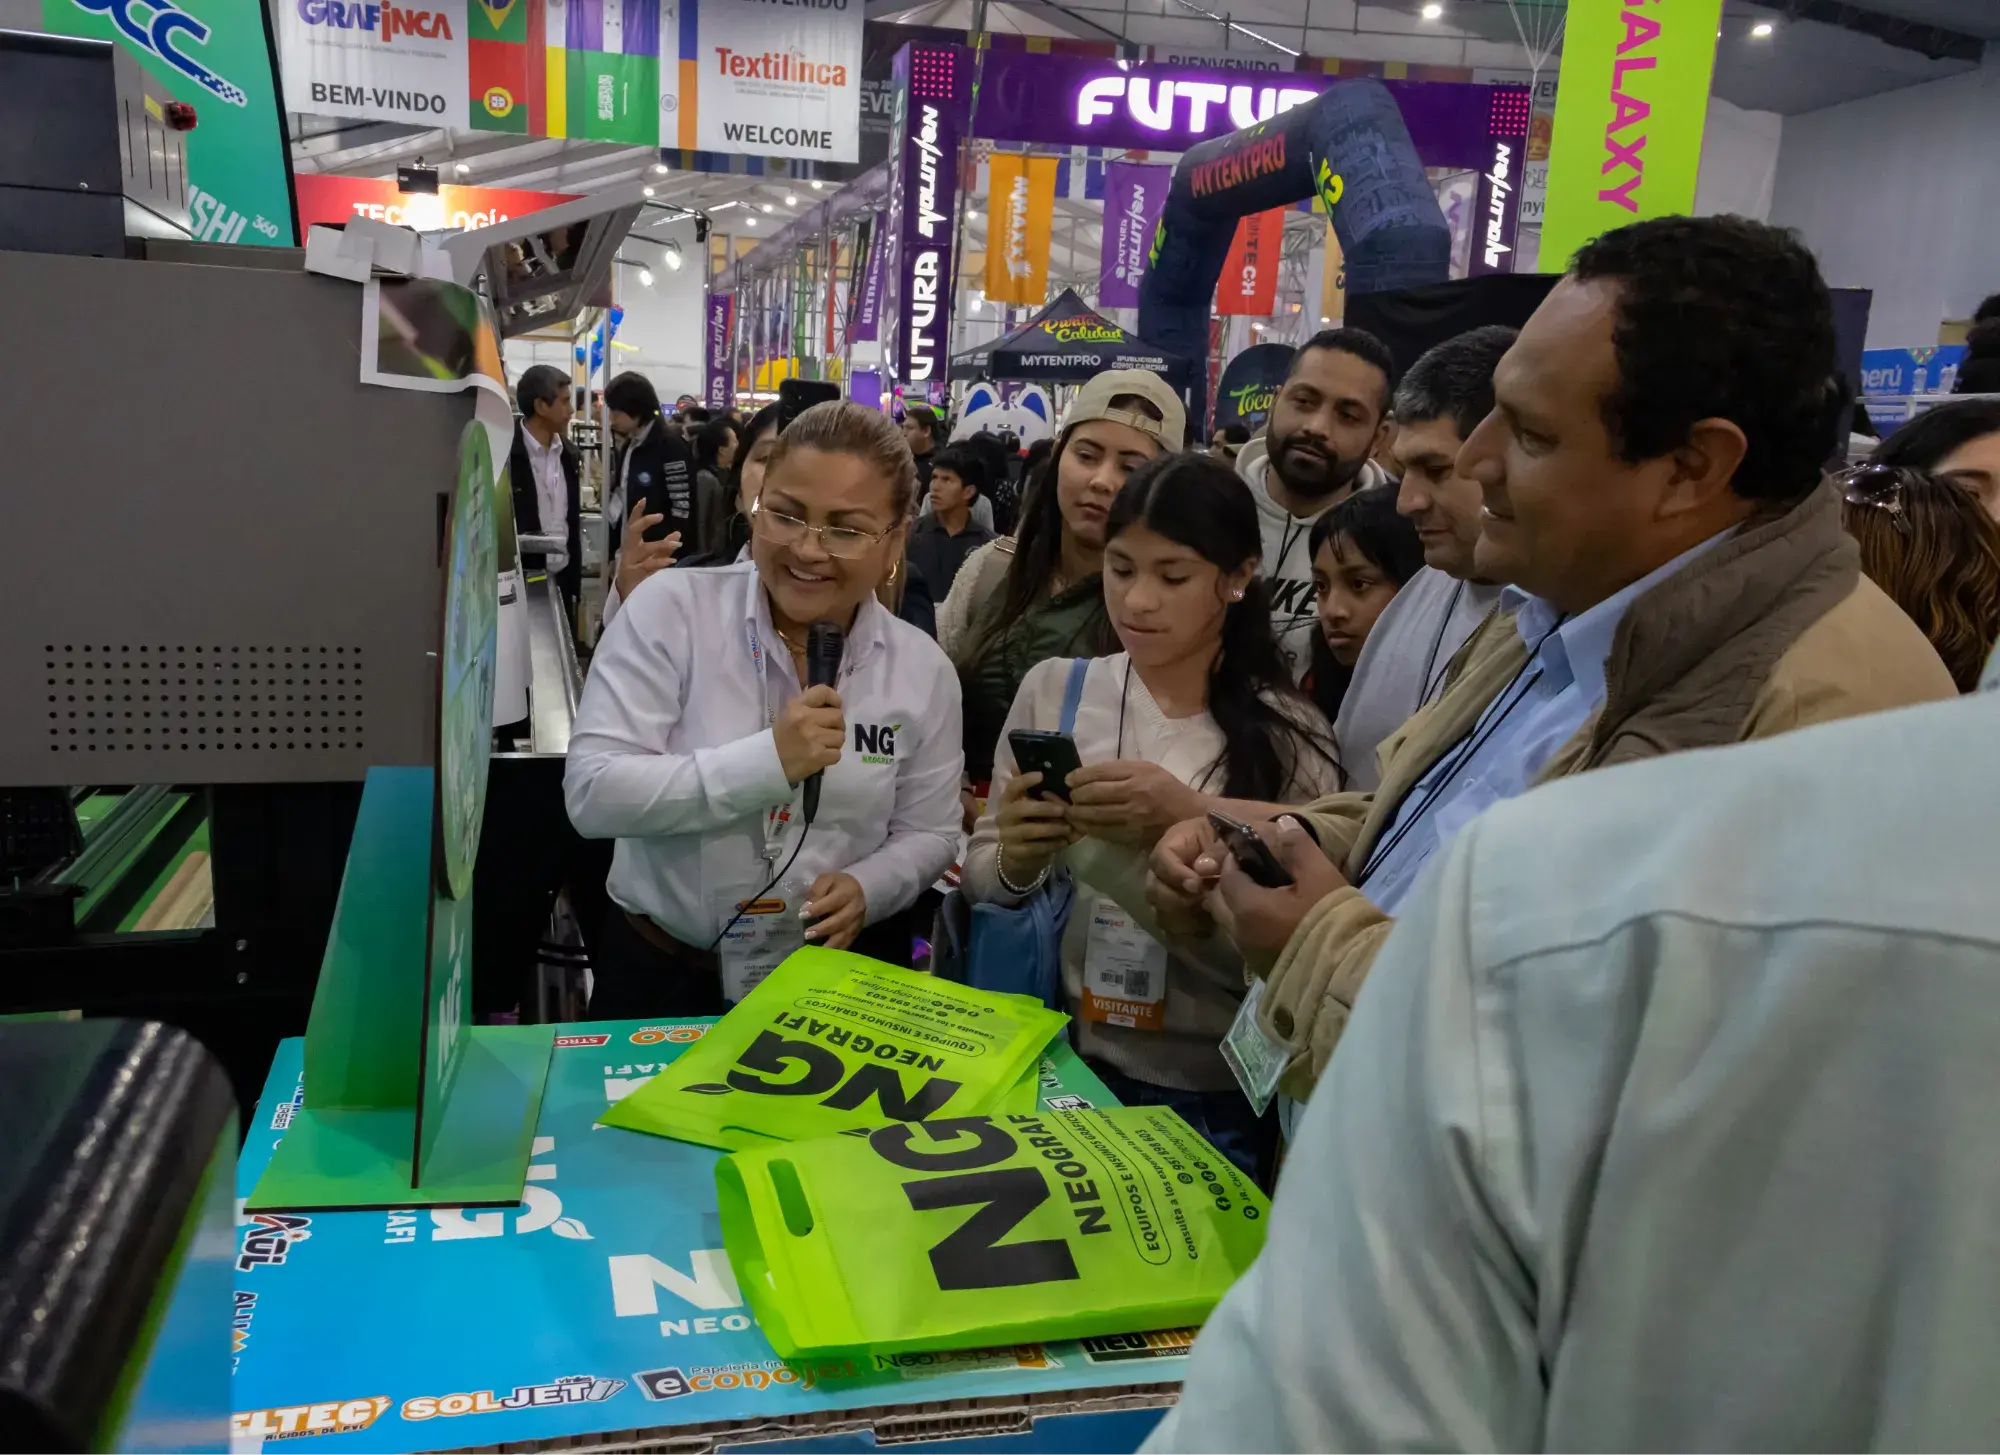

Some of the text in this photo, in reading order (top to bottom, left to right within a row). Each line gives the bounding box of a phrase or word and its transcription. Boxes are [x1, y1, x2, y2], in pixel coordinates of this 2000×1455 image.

[310, 82, 447, 114] BEM-VINDO
[1597, 0, 1663, 213] ALAXY
[723, 122, 832, 149] WELCOME
[1190, 132, 1286, 199] MYTENTPRO
[252, 214, 279, 238] 360
[1021, 354, 1101, 366] MYTENTPRO
[854, 723, 895, 756] NG
[865, 990, 934, 1014] 957 898 603
[1092, 996, 1153, 1018] VISITANTE
[772, 1011, 946, 1073] NEOGRAFI
[804, 999, 976, 1052] EQUIPOS E INSUMOS GRÁFICOS
[726, 1028, 964, 1124] NG
[1090, 1138, 1129, 1176] INSUMOS
[1134, 1128, 1186, 1171] 957 898 603
[1120, 1173, 1134, 1183] E
[1163, 1180, 1176, 1198] los
[868, 1114, 1081, 1291] NG
[1125, 1184, 1161, 1252] EQUIPOS
[1173, 1207, 1199, 1260] Consulta
[660, 1314, 761, 1337] NEO
[691, 1359, 792, 1375] Papelería fina
[403, 1381, 592, 1419] SOLJET
[342, 1423, 365, 1431] PVC
